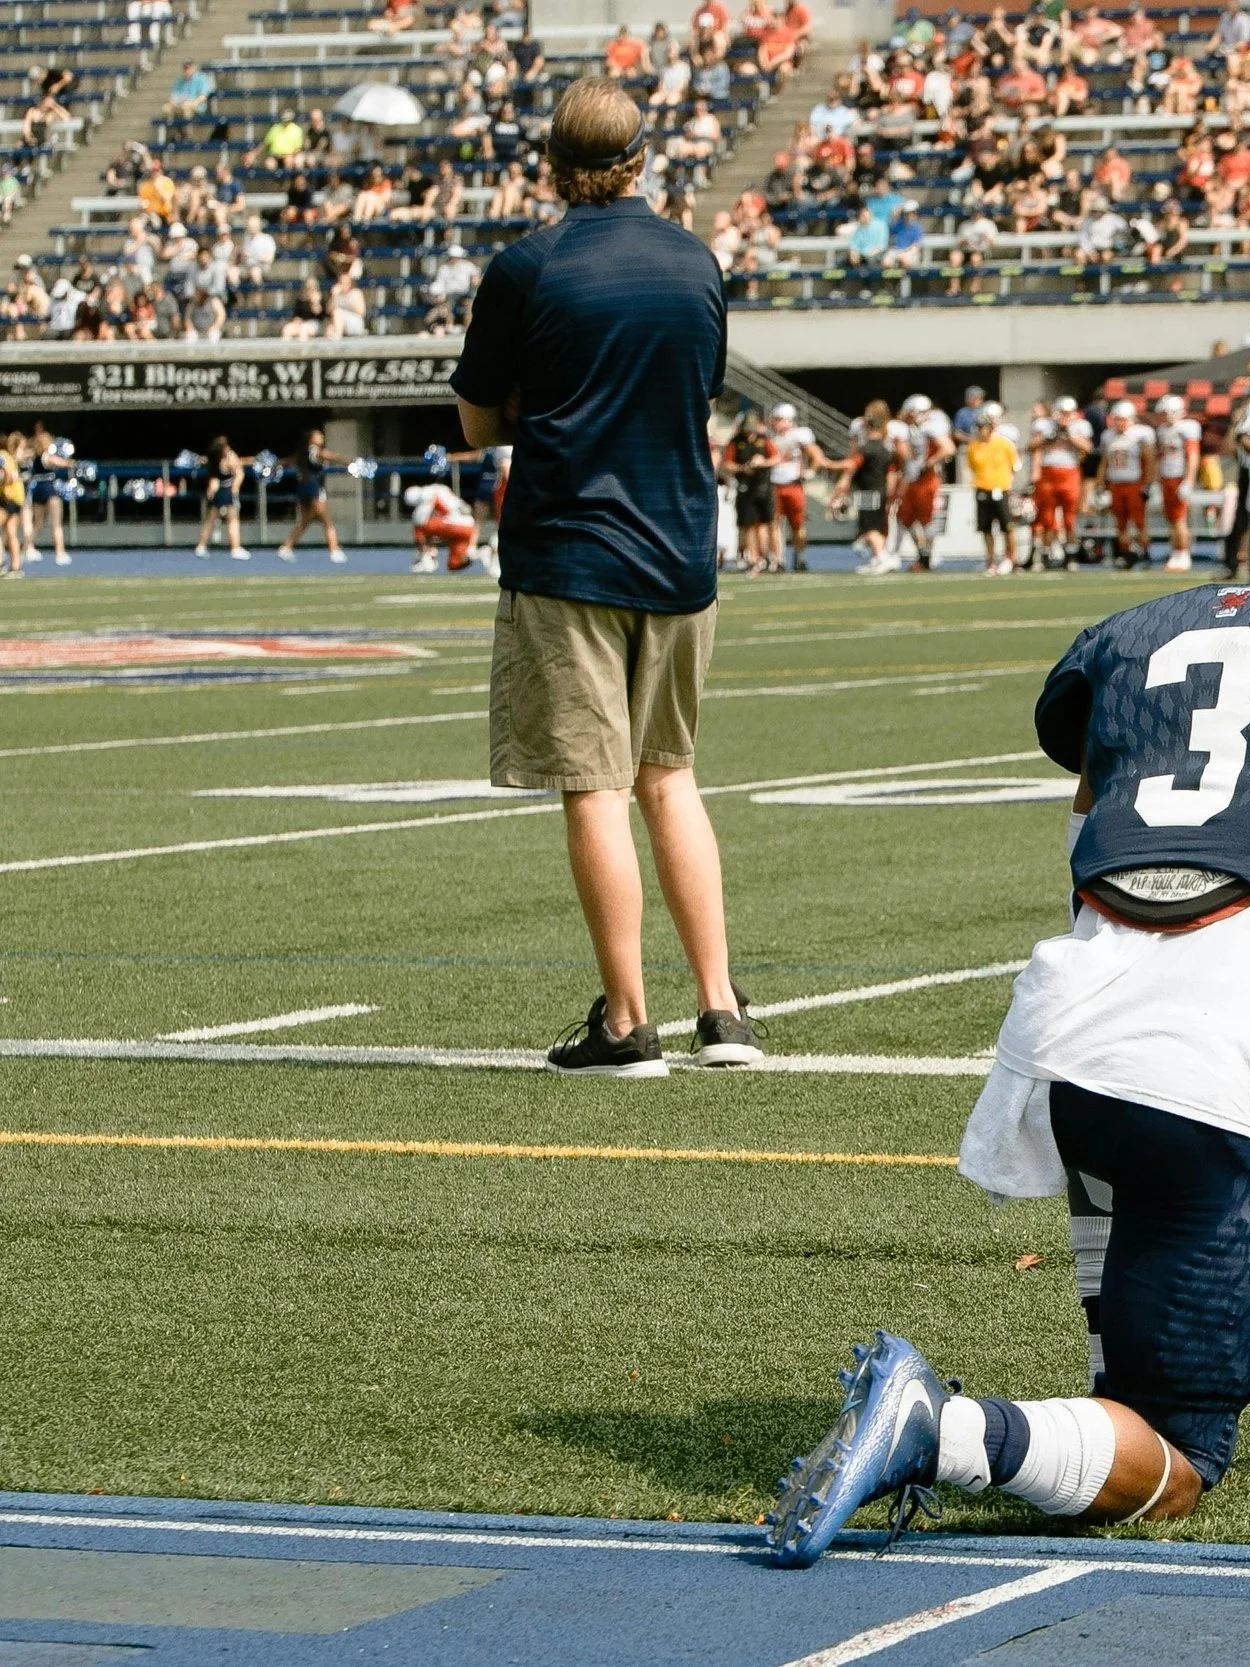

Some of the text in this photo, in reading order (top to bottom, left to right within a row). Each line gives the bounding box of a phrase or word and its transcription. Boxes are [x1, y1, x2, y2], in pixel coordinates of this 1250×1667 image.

[88, 362, 307, 387] 321 Bloor St. W
